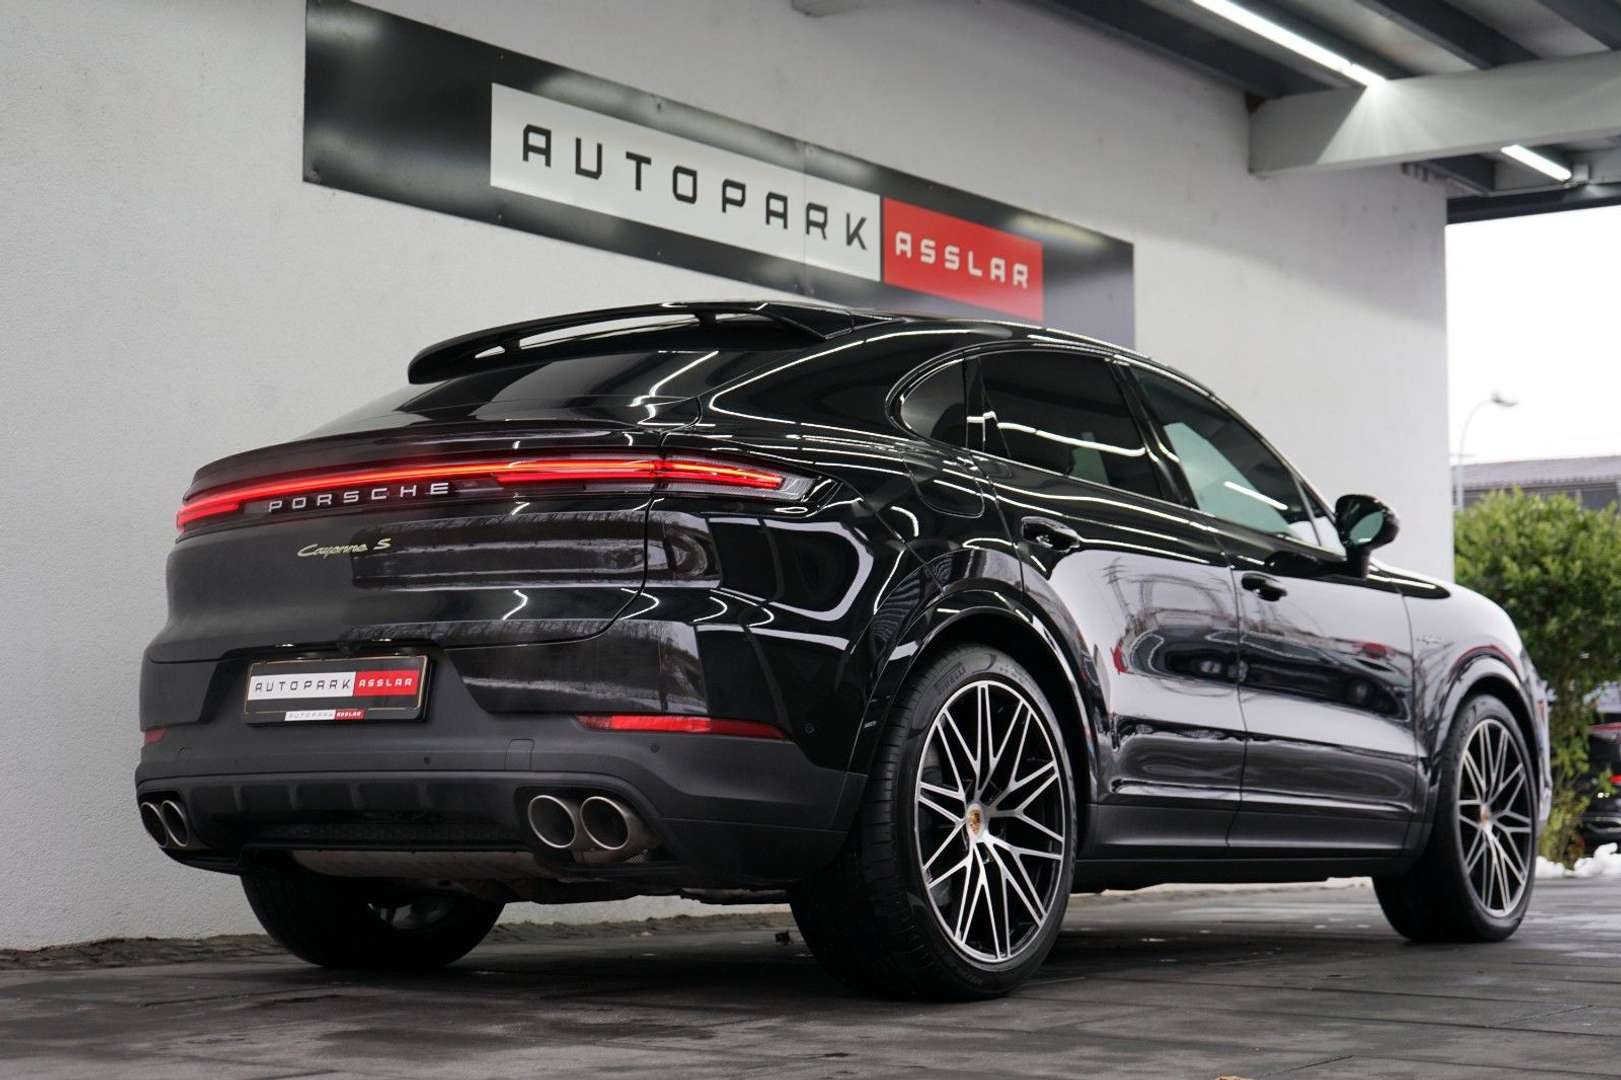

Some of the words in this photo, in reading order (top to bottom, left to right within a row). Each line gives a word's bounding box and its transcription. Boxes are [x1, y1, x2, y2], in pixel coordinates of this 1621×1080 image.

[522, 123, 868, 251] AUTOPARK
[895, 230, 1029, 289] ASSLAR
[267, 482, 450, 513] PORSCHE
[297, 543, 369, 559] Cayenne
[373, 538, 391, 550] S
[256, 680, 351, 692] AUTOPARK
[358, 678, 413, 688] ASSLAR
